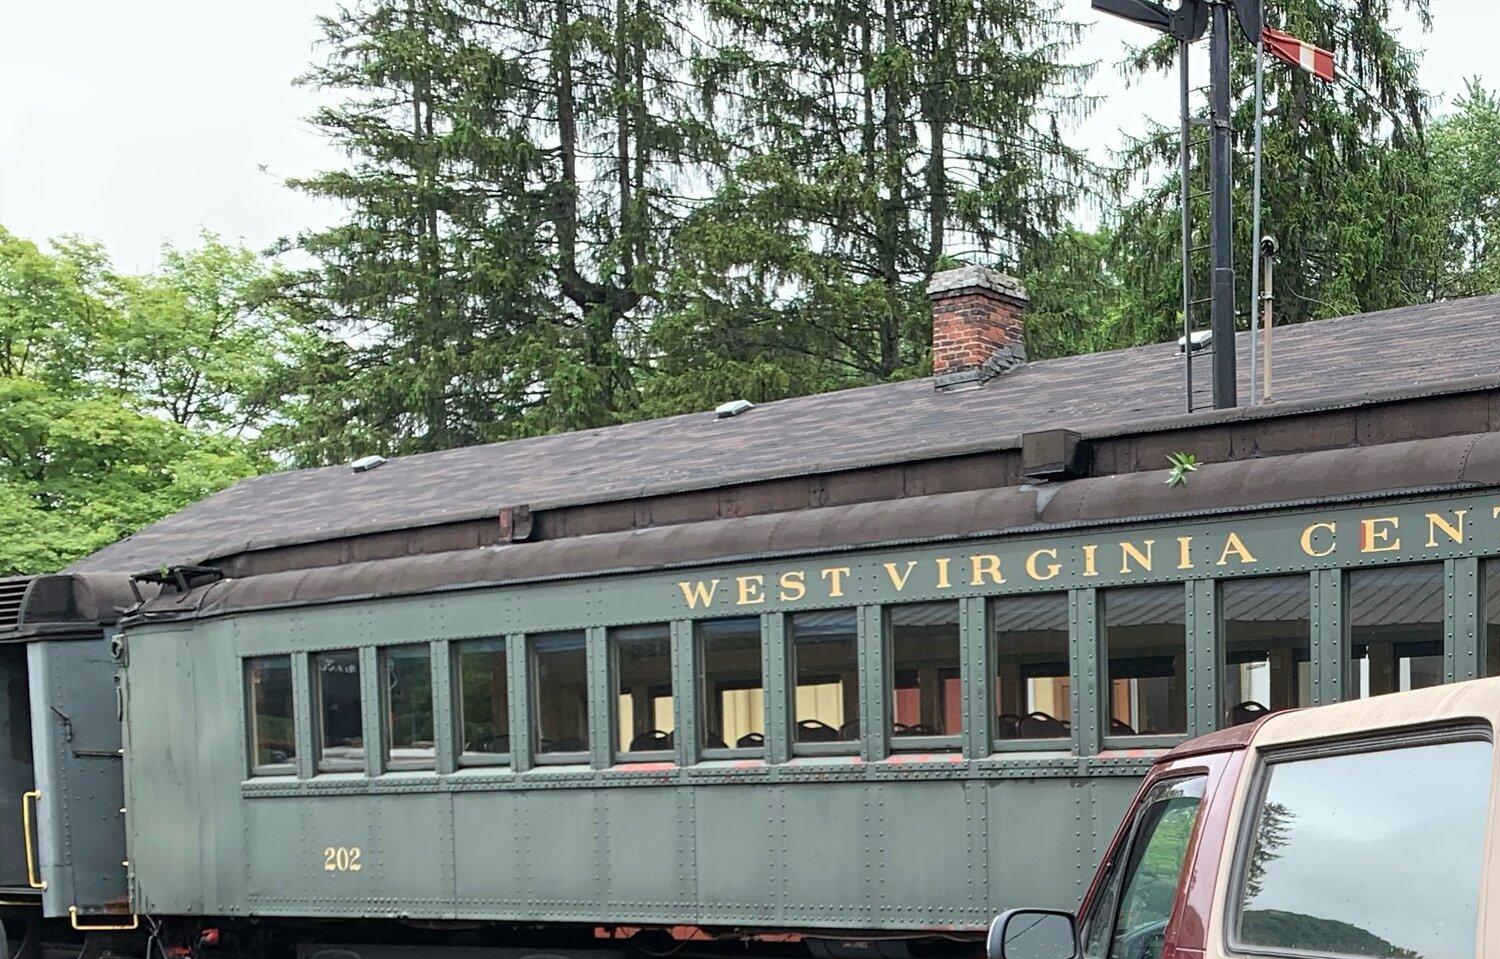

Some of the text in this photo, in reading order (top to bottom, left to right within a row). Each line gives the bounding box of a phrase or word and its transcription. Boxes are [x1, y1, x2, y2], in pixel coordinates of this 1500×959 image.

[678, 565, 852, 610] WEST
[882, 532, 1258, 592] VIRGINIA
[324, 846, 361, 871] 202
